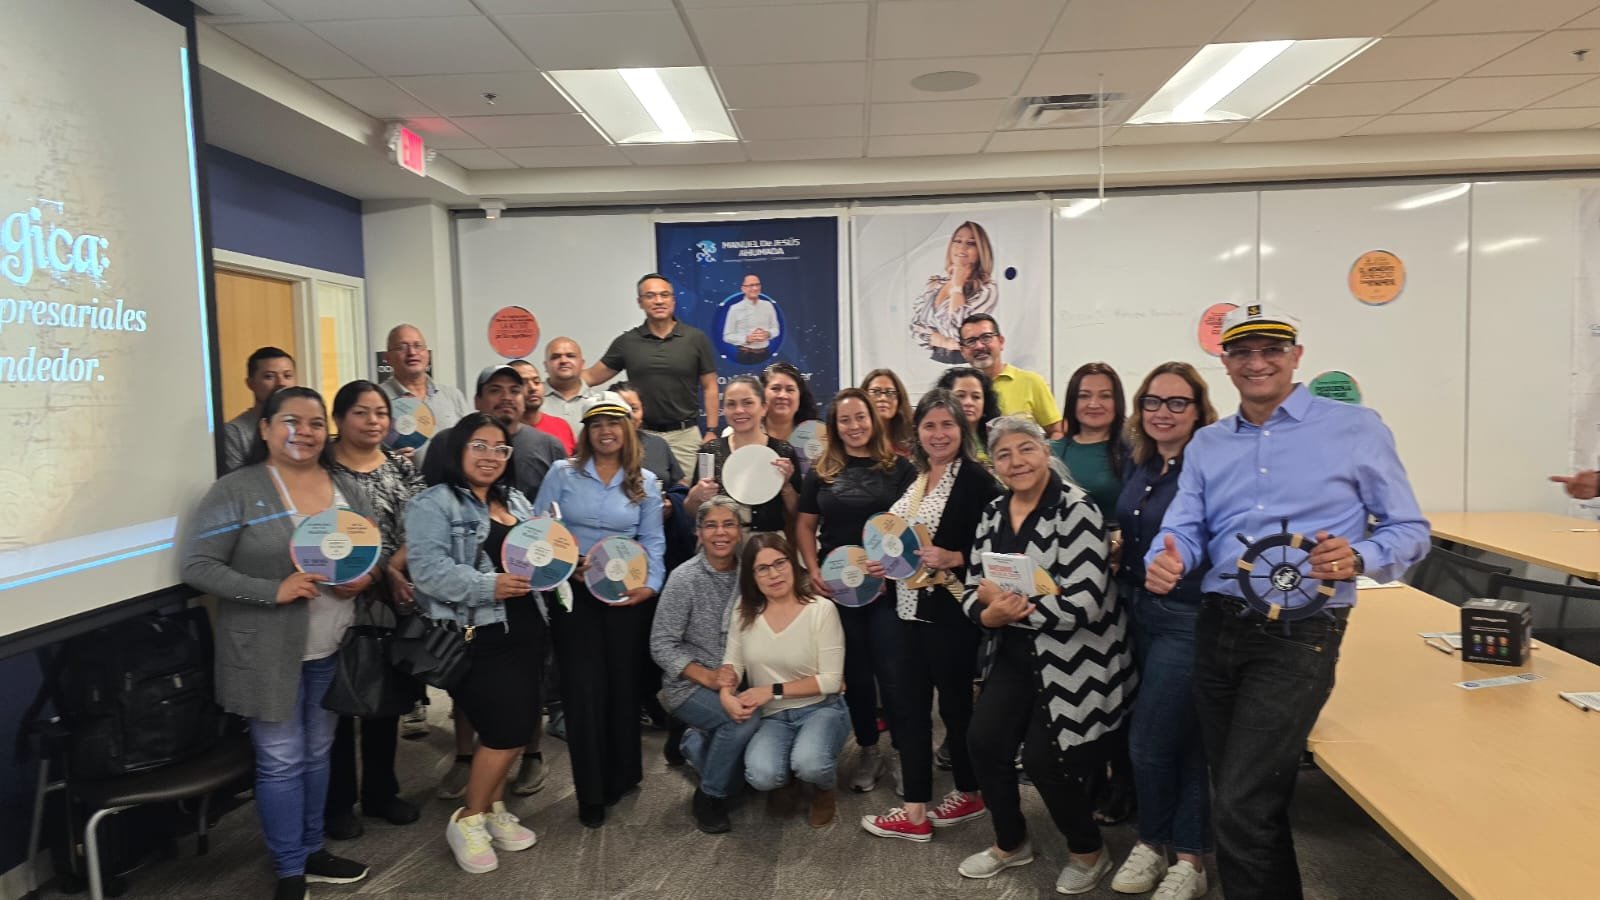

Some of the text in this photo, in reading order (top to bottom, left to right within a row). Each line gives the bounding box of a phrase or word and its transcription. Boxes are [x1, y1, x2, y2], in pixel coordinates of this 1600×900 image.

[722, 240, 760, 249] MANUEL
[773, 237, 800, 247] JESÚS
[738, 247, 785, 257] AHUMADA
